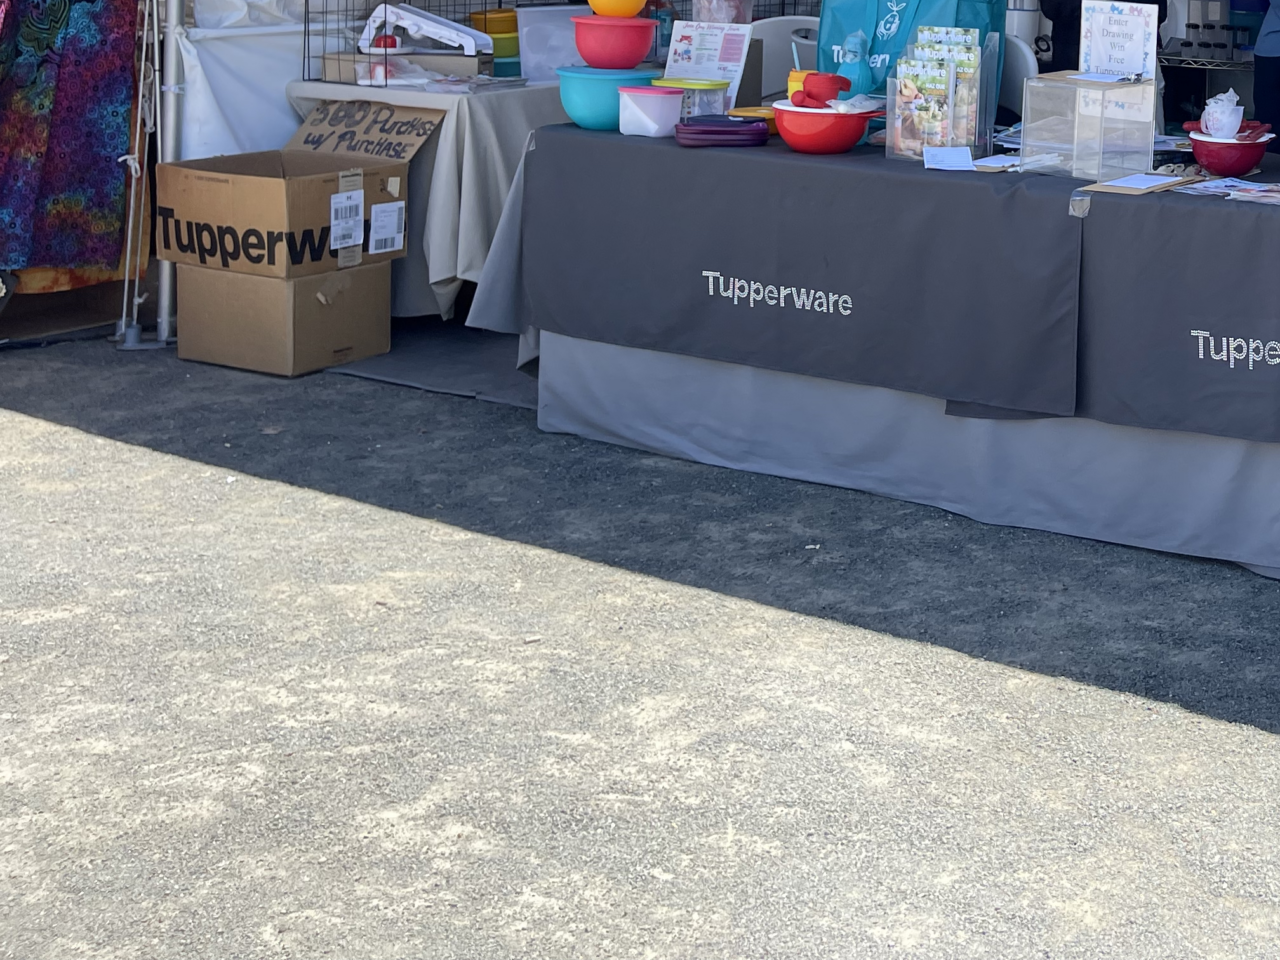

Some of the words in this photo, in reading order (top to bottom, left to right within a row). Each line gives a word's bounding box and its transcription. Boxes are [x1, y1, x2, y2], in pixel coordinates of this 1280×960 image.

[1108, 16, 1128, 27] Enter
[926, 31, 972, 43] Tupperware
[1102, 28, 1134, 41] Drawing
[1109, 41, 1125, 52] Win
[926, 48, 975, 61] Tupperware
[1108, 54, 1125, 64] Free
[900, 64, 946, 77] Tupperware
[702, 270, 853, 316] Tupperware
